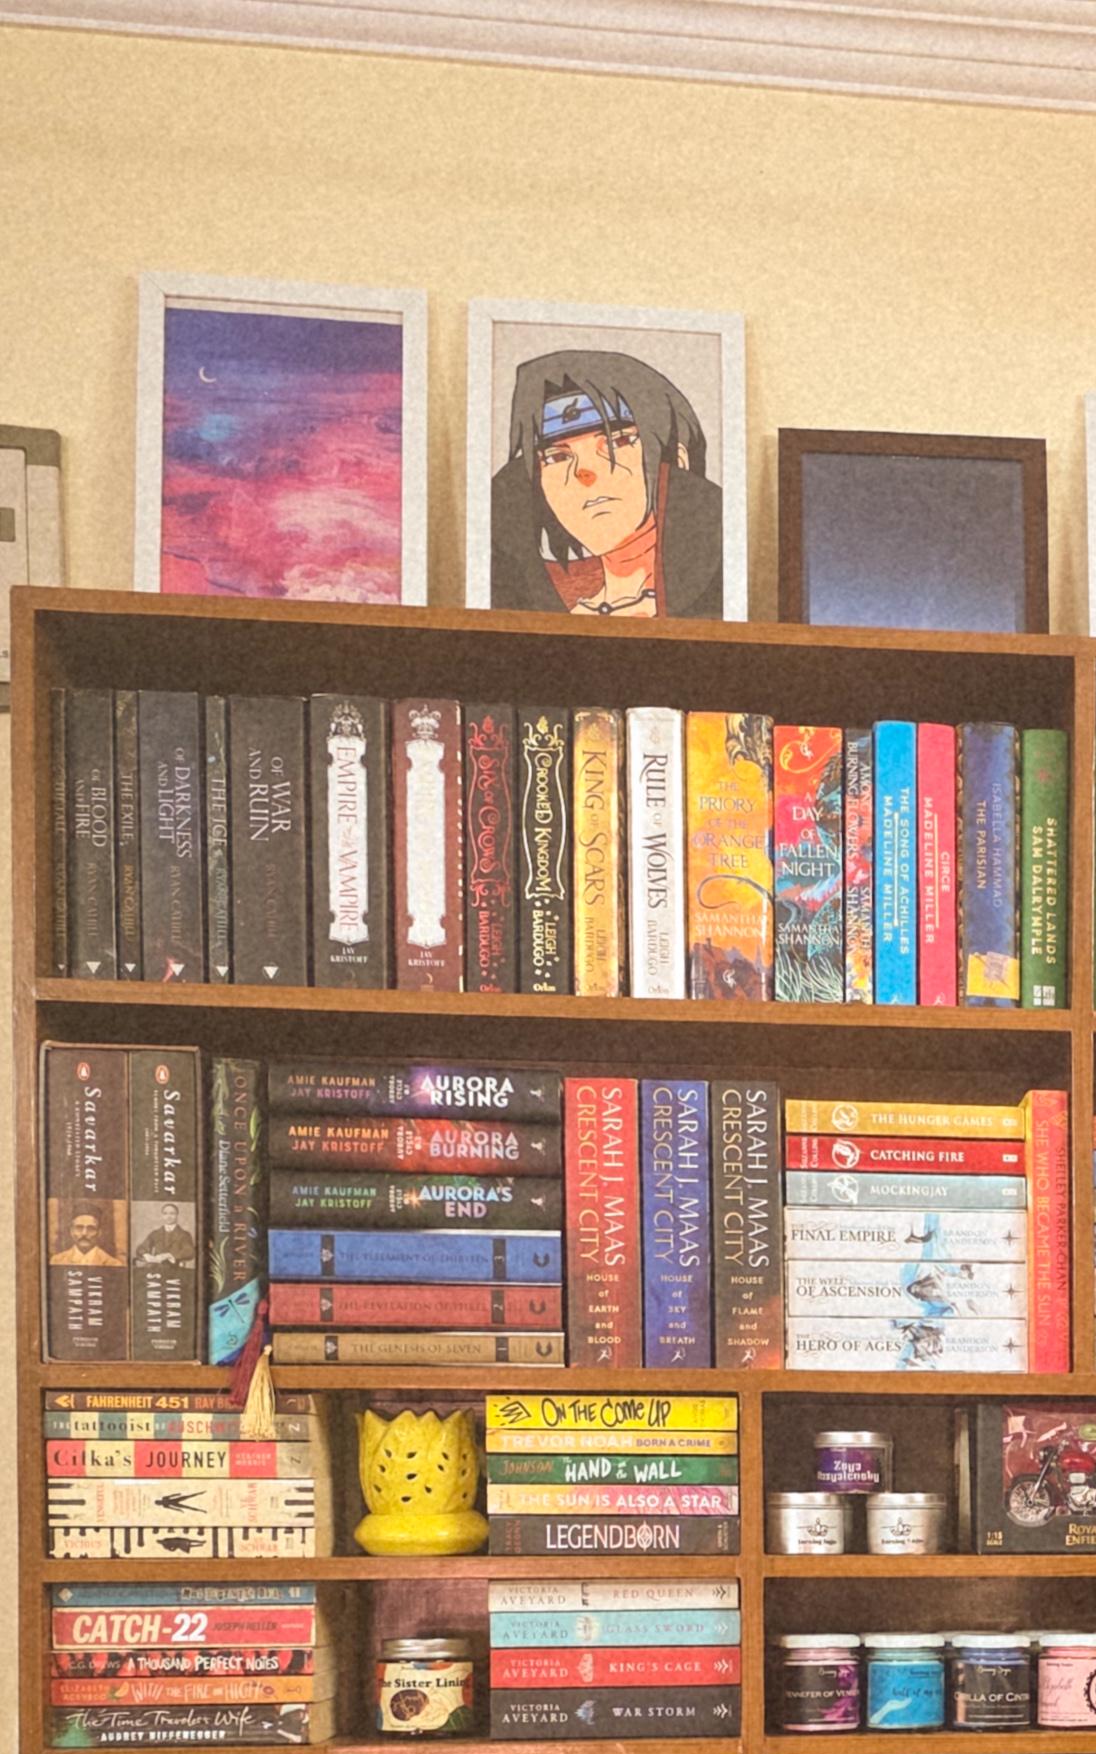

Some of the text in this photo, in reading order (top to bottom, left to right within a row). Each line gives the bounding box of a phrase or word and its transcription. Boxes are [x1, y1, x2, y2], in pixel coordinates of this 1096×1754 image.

[791, 806, 823, 821] DAY
[801, 828, 816, 840] OF
[780, 844, 840, 859] FALLEN
[781, 860, 836, 877] NIGHT
[940, 852, 949, 893] CIRCE
[532, 910, 543, 967] BARDUGO
[545, 920, 557, 956] LEIGH
[422, 1076, 513, 1093] AURORA
[430, 1090, 508, 1107] RISING
[85, 1086, 101, 1192] Savarkar
[289, 1126, 389, 1138] AMIE KAUFMAN
[292, 1141, 383, 1152] JAY KRISTOFF
[870, 1150, 964, 1162] CATCHING FIRE
[576, 1085, 599, 1263] CRESCENT CITY
[601, 1086, 624, 1266] SARAH J. MAAS
[419, 1186, 513, 1201] AURORA'S
[870, 1186, 947, 1197] MOCKINGJAY
[445, 1202, 486, 1218] END
[67, 1271, 82, 1331] SAMPATH
[88, 1276, 102, 1327] VIKRAM
[87, 1395, 189, 1408] FAHRENHEIT 451
[146, 1451, 227, 1467] JOURNEY
[617, 1494, 721, 1508] ALSO A STAR
[546, 1524, 679, 1549] LEGENDBORN
[73, 1613, 208, 1642] CATCH-22
[511, 1704, 560, 1712] VICTORIA
[612, 1707, 695, 1716] WAR STORM
[503, 1712, 568, 1723] AVEYARD
